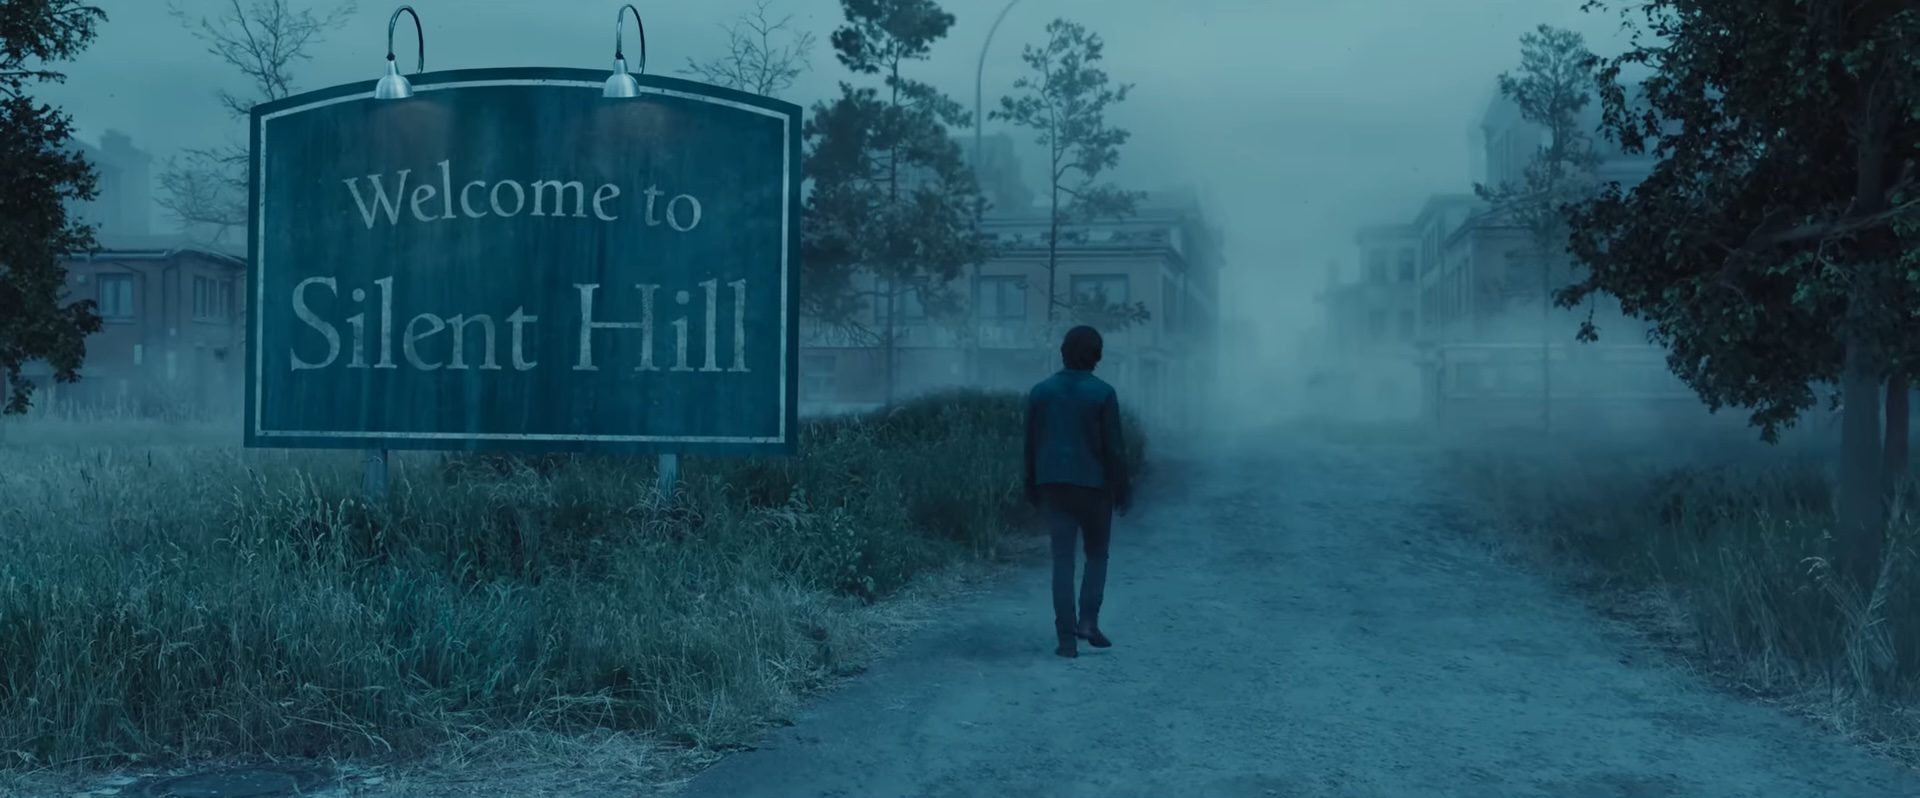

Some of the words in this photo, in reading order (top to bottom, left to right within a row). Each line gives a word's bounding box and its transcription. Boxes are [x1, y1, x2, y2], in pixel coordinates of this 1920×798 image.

[343, 159, 621, 230] Welcome
[644, 184, 702, 232] to
[290, 276, 538, 372] Silent
[573, 279, 751, 373] Hill
